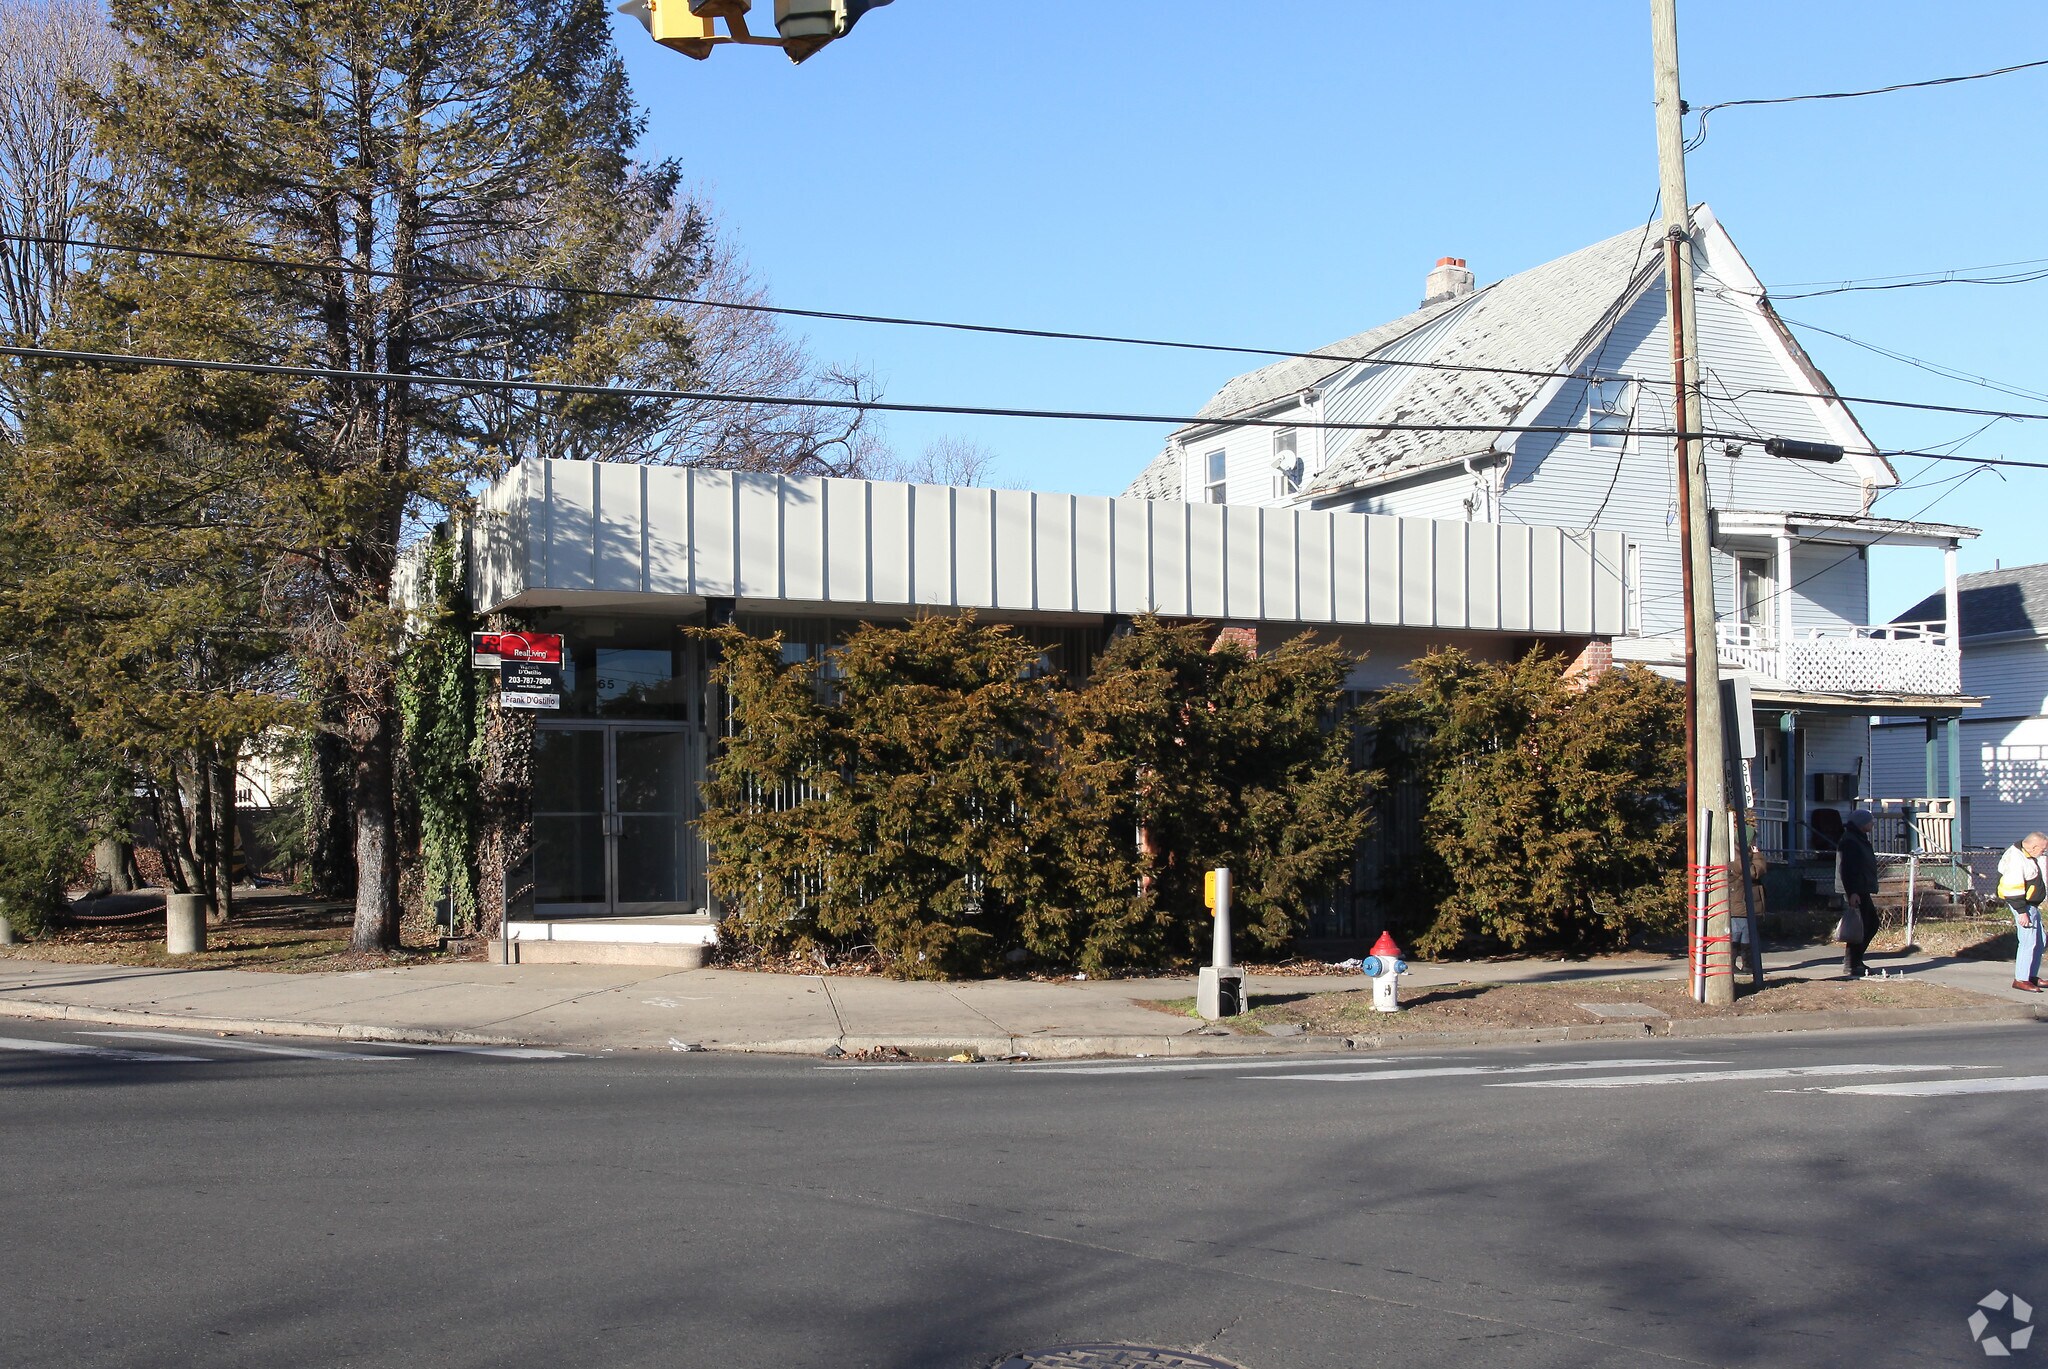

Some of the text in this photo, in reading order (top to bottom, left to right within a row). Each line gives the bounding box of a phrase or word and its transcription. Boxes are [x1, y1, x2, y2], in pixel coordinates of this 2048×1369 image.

[508, 676, 552, 685] 203-787-7800
[598, 679, 615, 690] 65
[505, 695, 556, 705] Frank D'Ostilio
[1742, 762, 1752, 804] STOP
